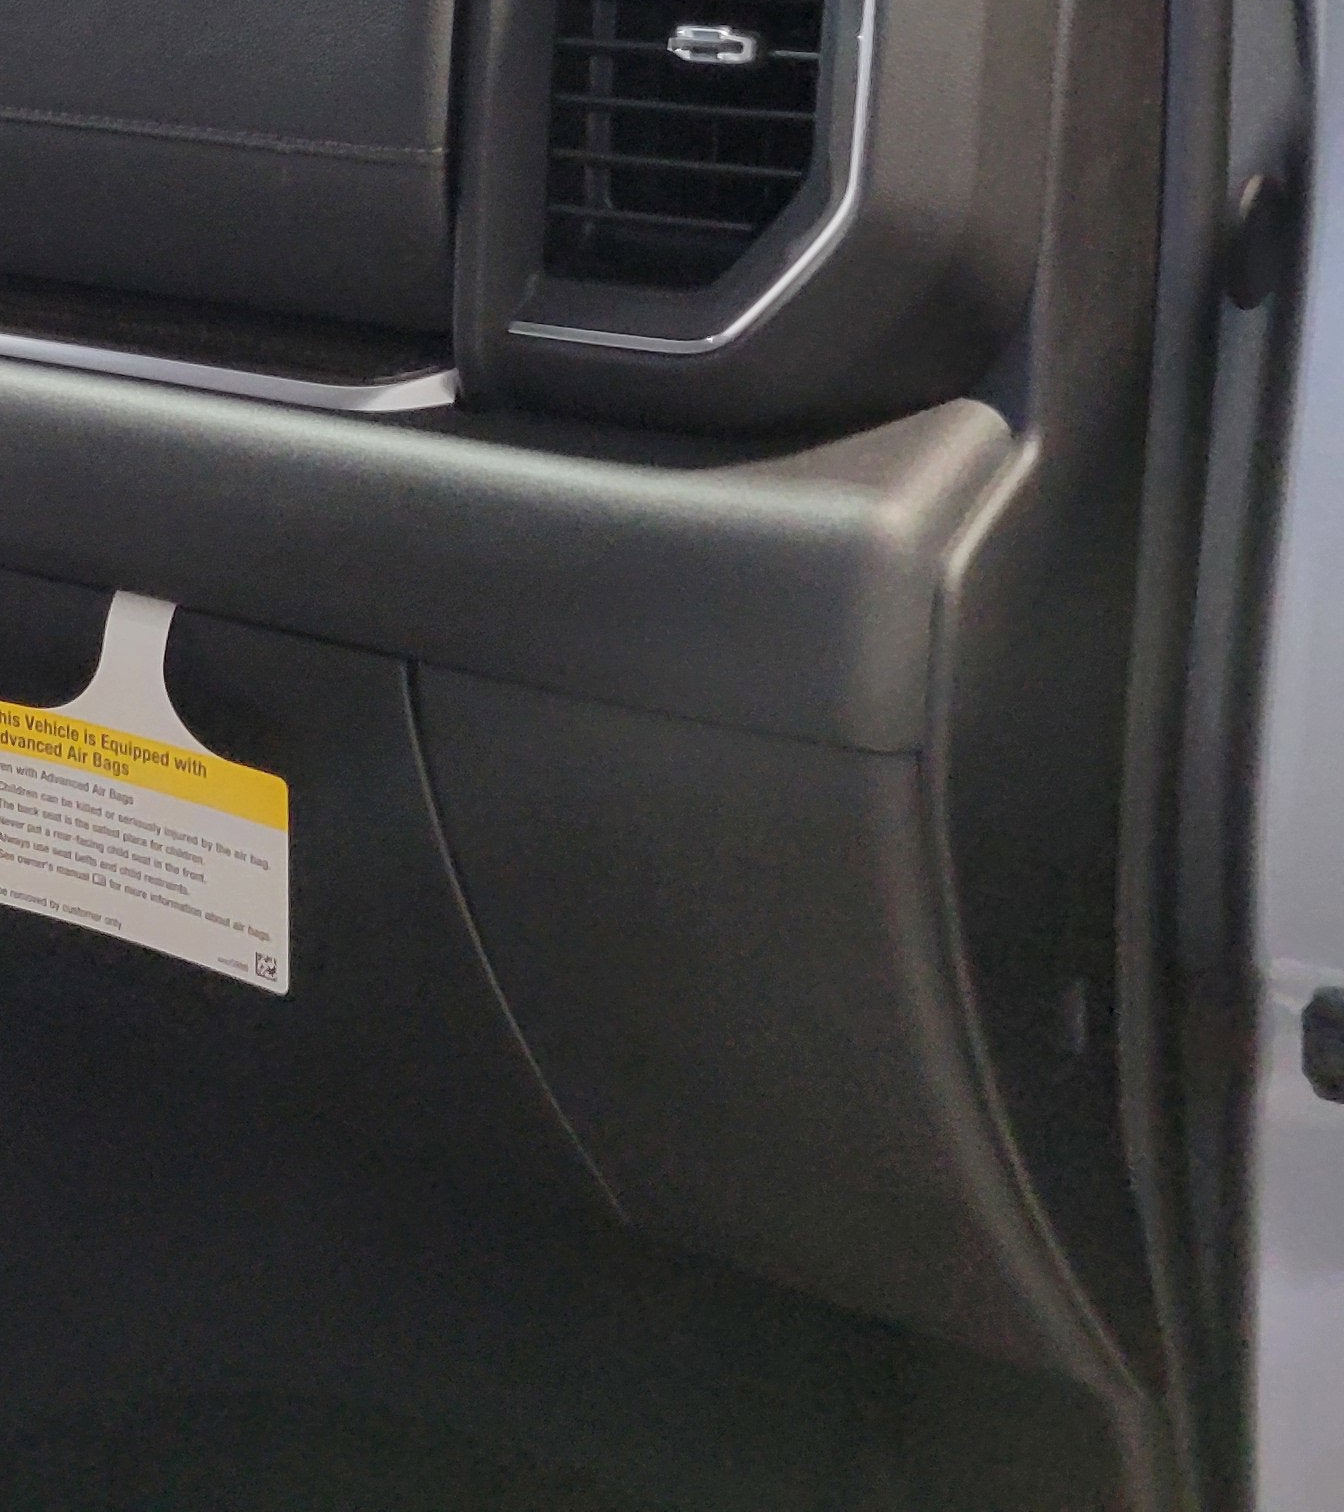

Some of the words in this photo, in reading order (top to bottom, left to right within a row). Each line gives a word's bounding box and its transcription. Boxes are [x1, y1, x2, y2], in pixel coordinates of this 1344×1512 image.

[25, 716, 79, 744] Vehicle
[84, 731, 95, 748] is
[101, 735, 169, 770] Equipped
[174, 754, 206, 778] with
[67, 746, 86, 765] Air
[92, 752, 128, 778] Bags
[16, 765, 37, 779] with
[40, 771, 88, 792] Advanced
[92, 783, 105, 796] Air
[109, 788, 133, 806] Bags
[40, 791, 58, 805] can
[61, 797, 72, 808] be
[201, 837, 212, 852] by
[216, 842, 230, 856] the
[234, 848, 246, 861] air
[150, 839, 162, 851] for
[165, 860, 179, 874] the
[49, 898, 59, 912] by
